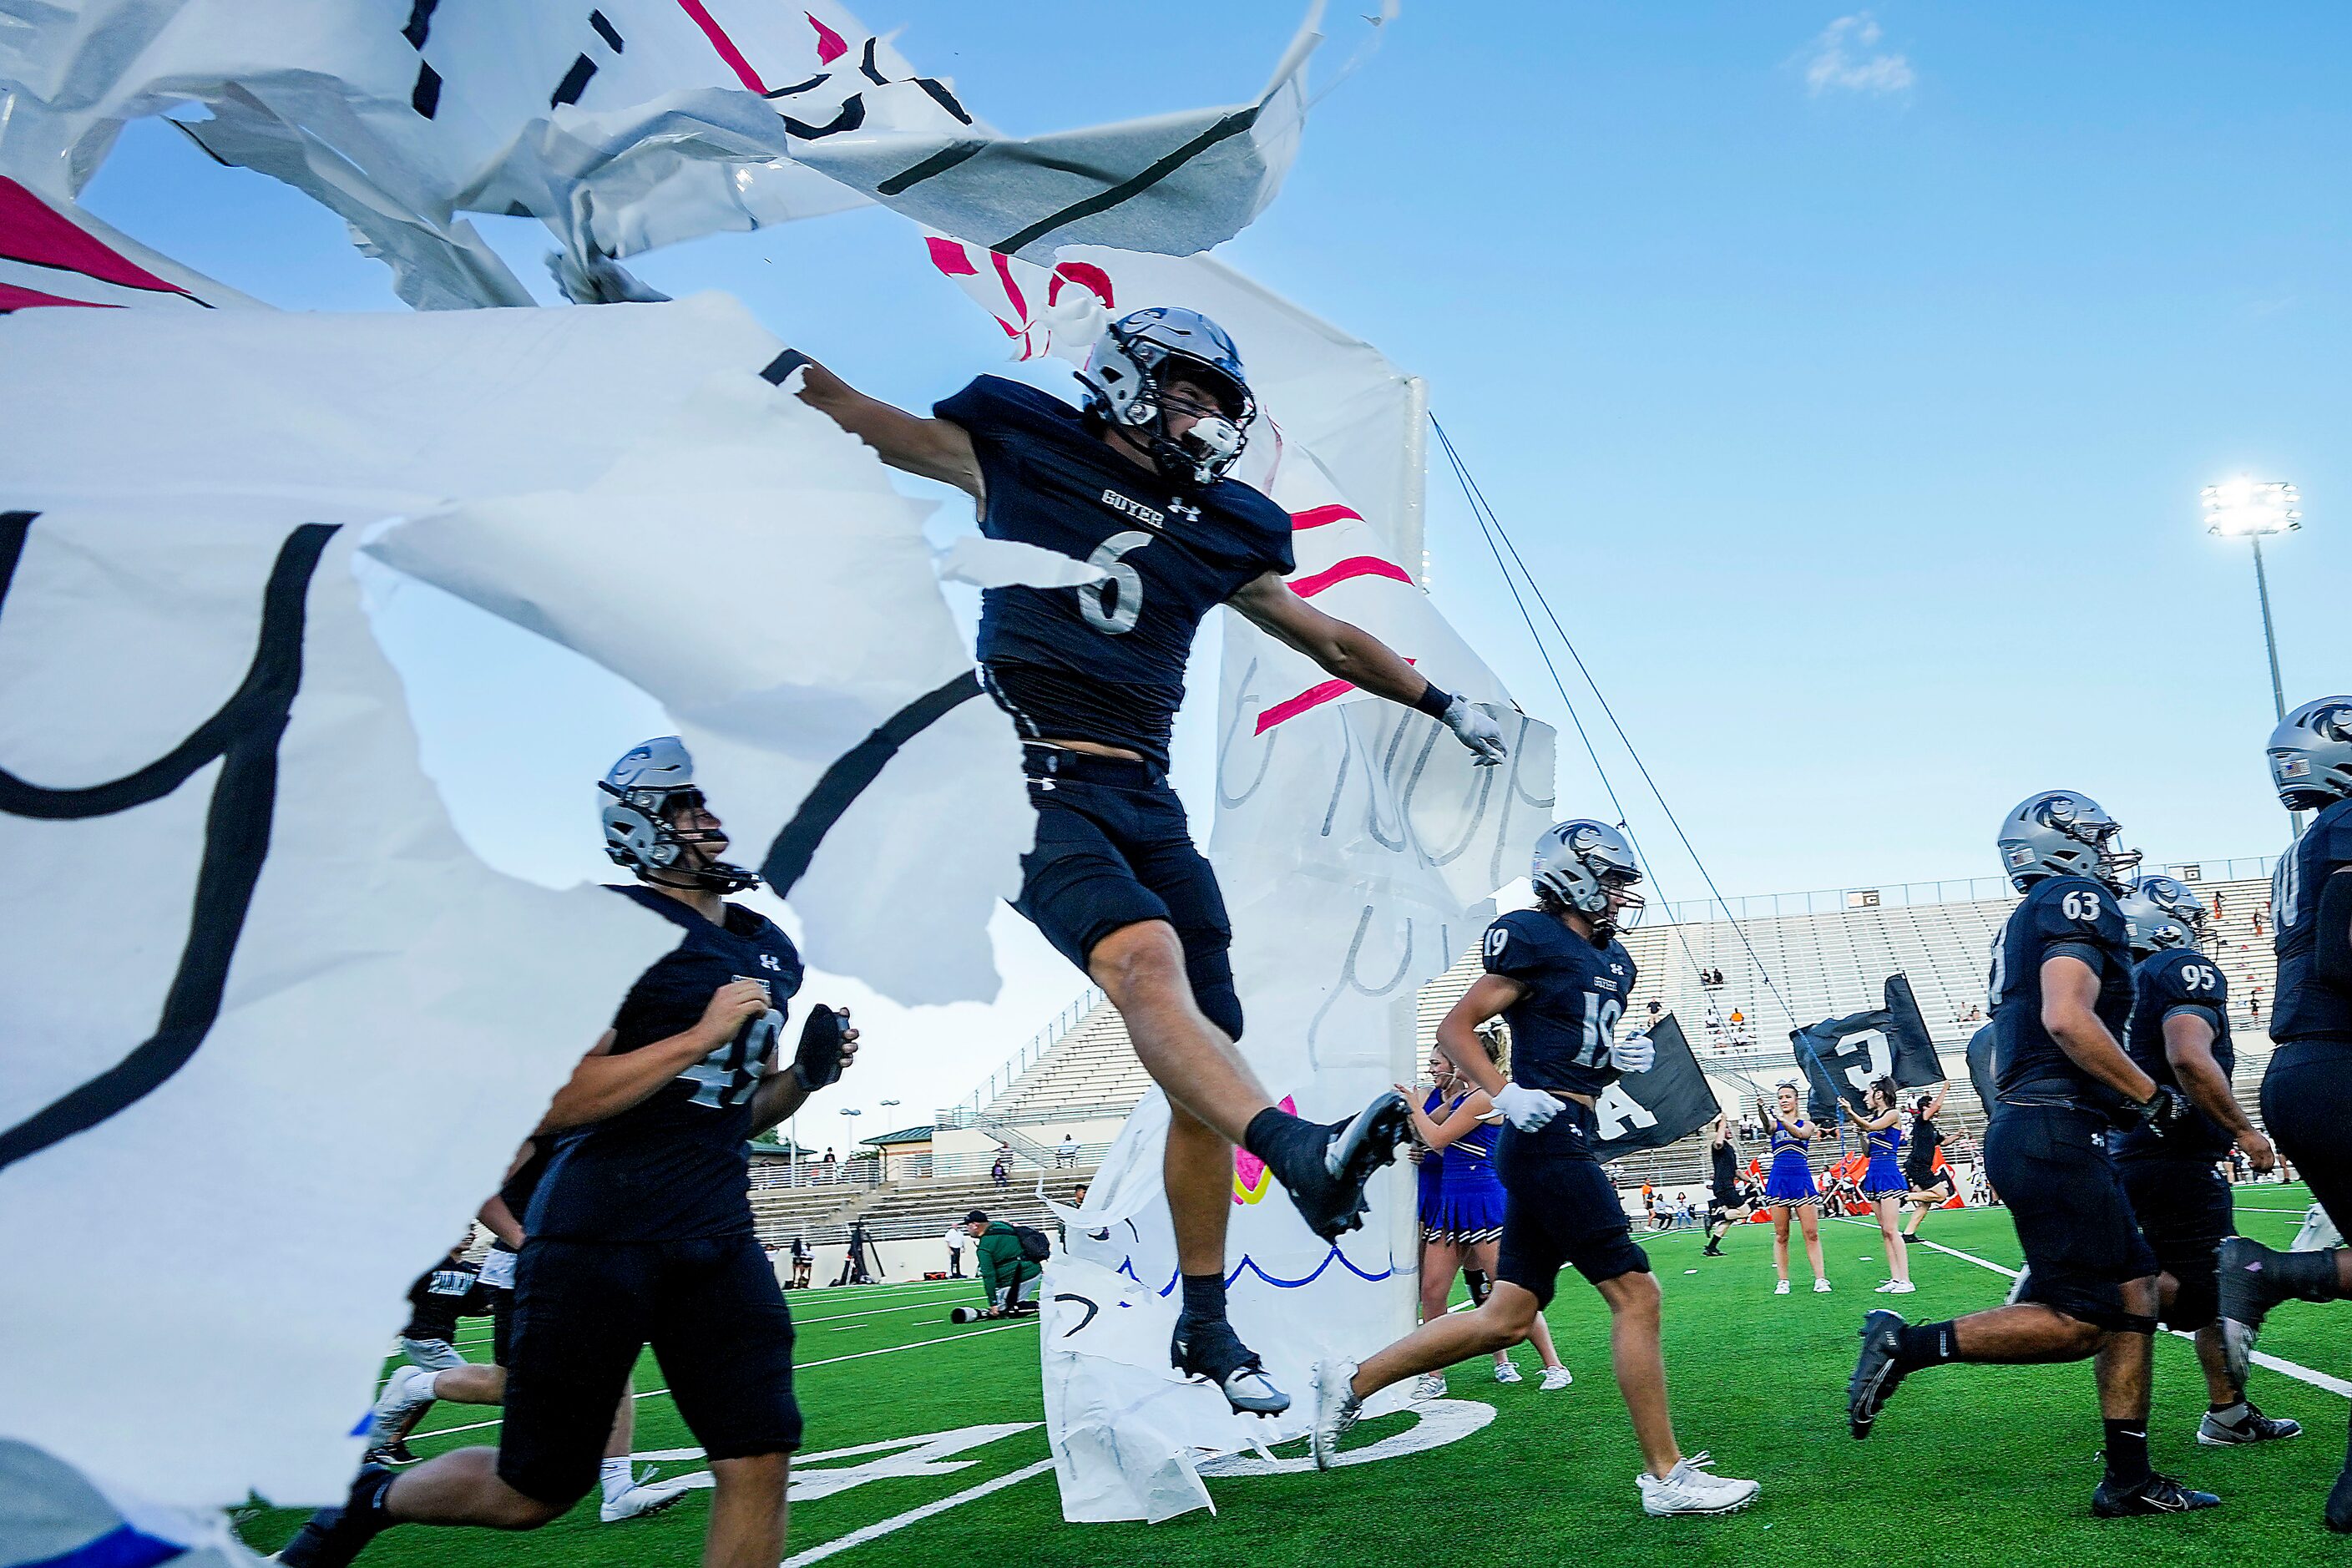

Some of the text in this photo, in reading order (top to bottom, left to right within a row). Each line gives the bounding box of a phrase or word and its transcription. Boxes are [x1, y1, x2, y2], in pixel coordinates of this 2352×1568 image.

[1101, 489, 1164, 529] GUYER
[1076, 530, 1154, 635] 6
[2061, 890, 2102, 922] 63
[1483, 928, 1510, 958] 19
[2181, 964, 2217, 991] 95
[1595, 1080, 1659, 1141] A
